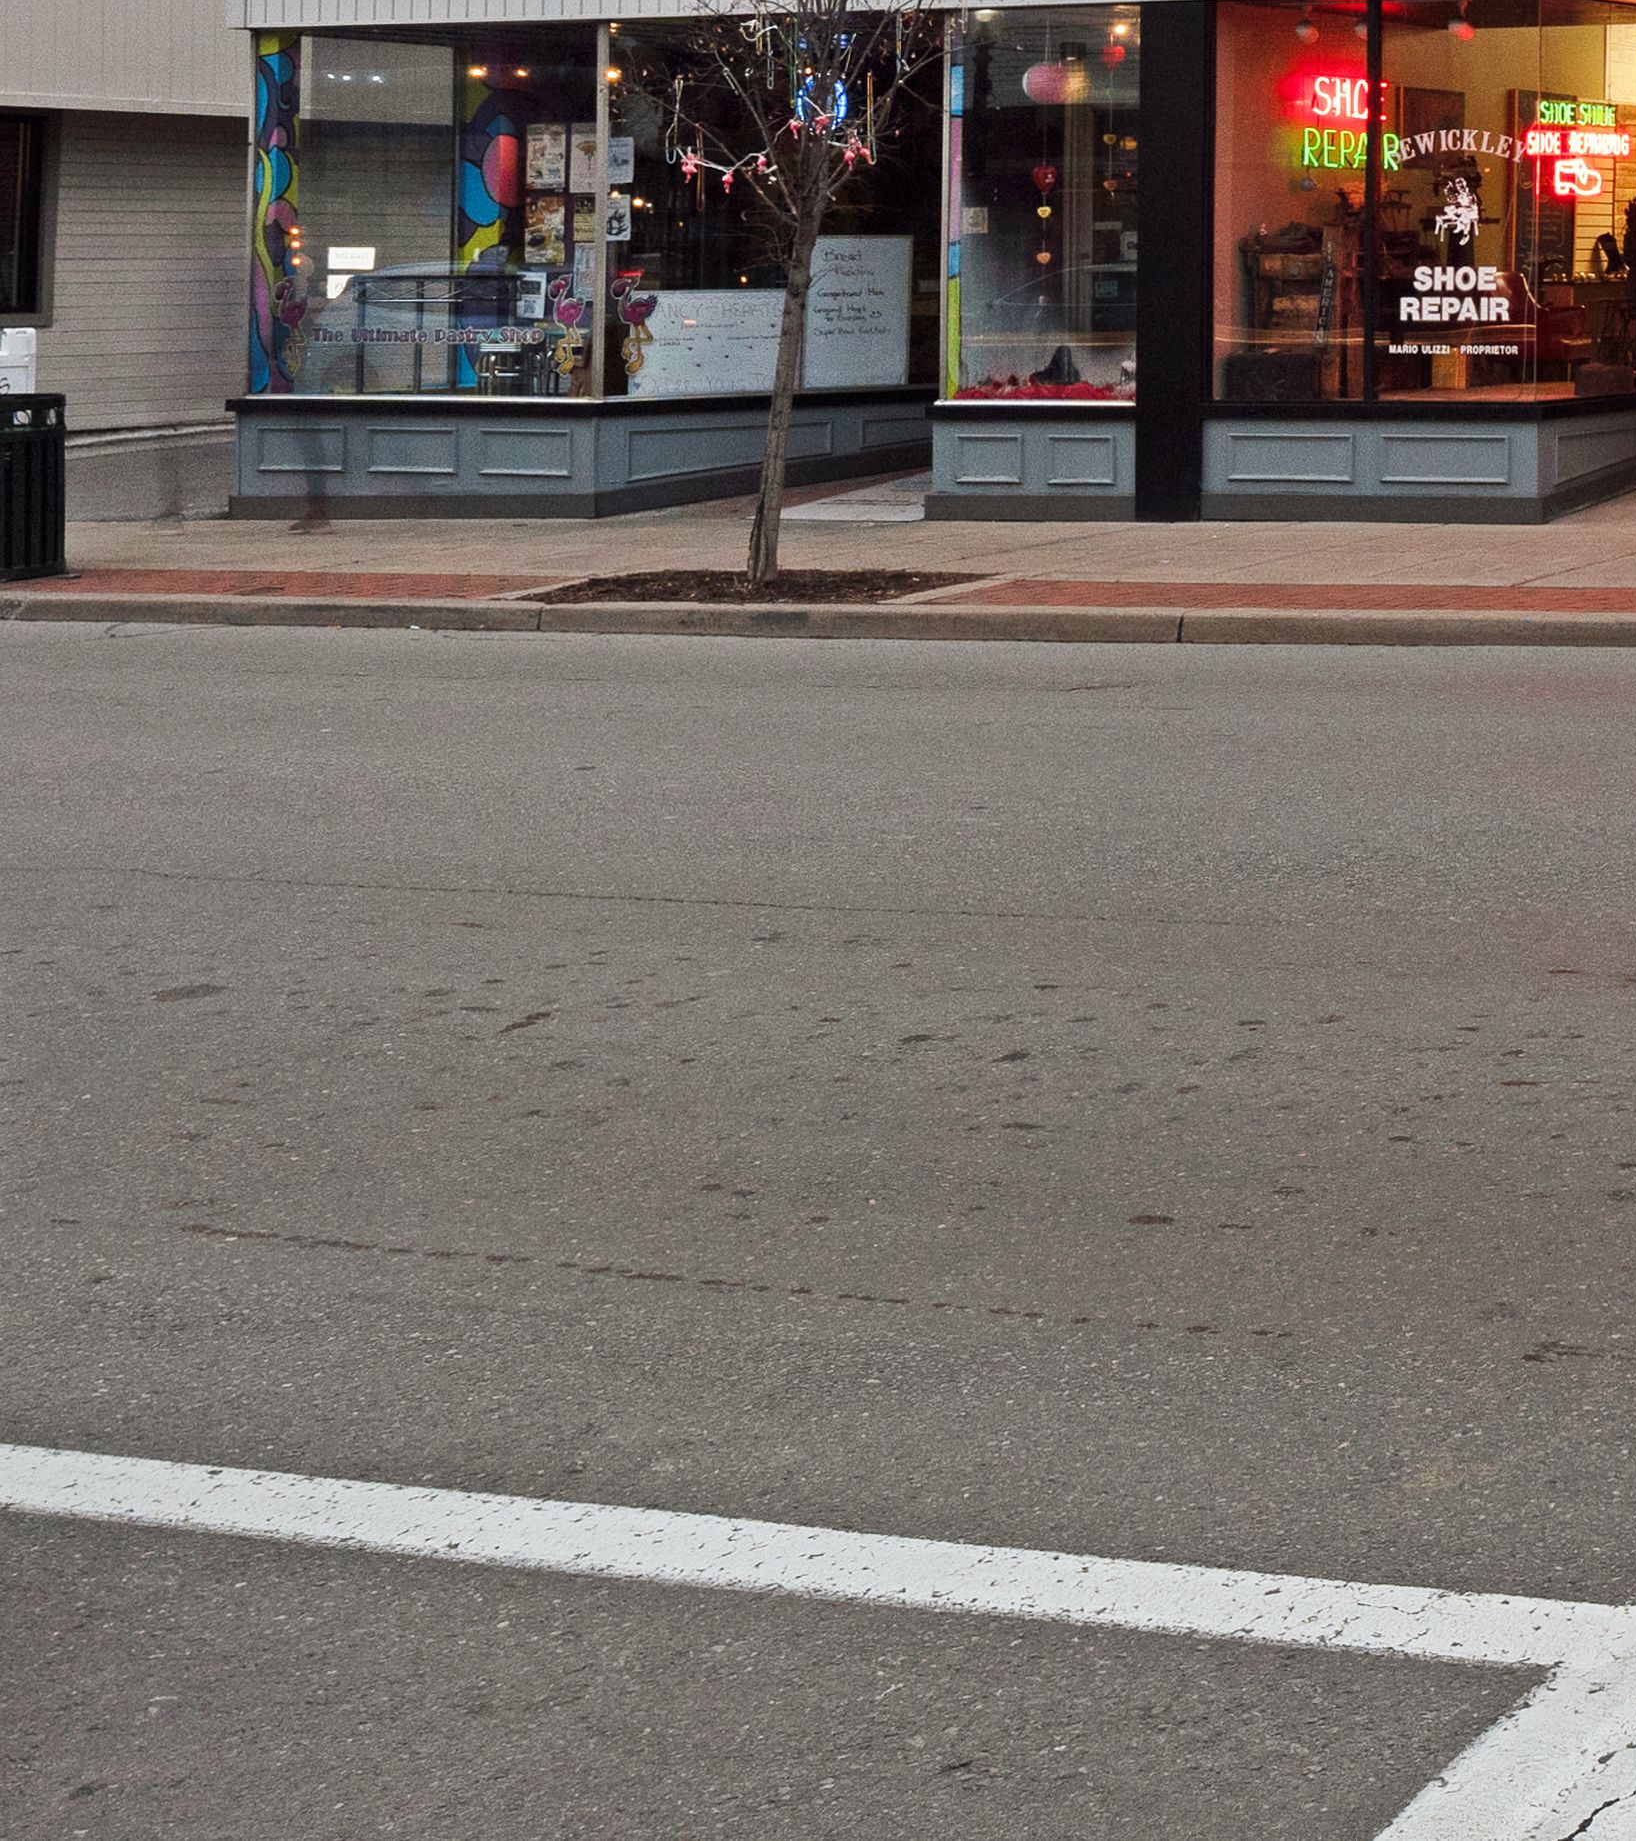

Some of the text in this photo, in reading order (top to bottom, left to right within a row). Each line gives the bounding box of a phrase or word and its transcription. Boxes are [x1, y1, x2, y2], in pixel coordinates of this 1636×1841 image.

[1312, 76, 1388, 120] SHO
[1303, 127, 1399, 171] REPAR
[1413, 266, 1497, 291] SHOE
[1400, 297, 1510, 321] REPAIR
[312, 325, 545, 344] The Ultimate Pastry Shop
[1389, 345, 1519, 355] MARIO ULIZZI PROPRIETOR
